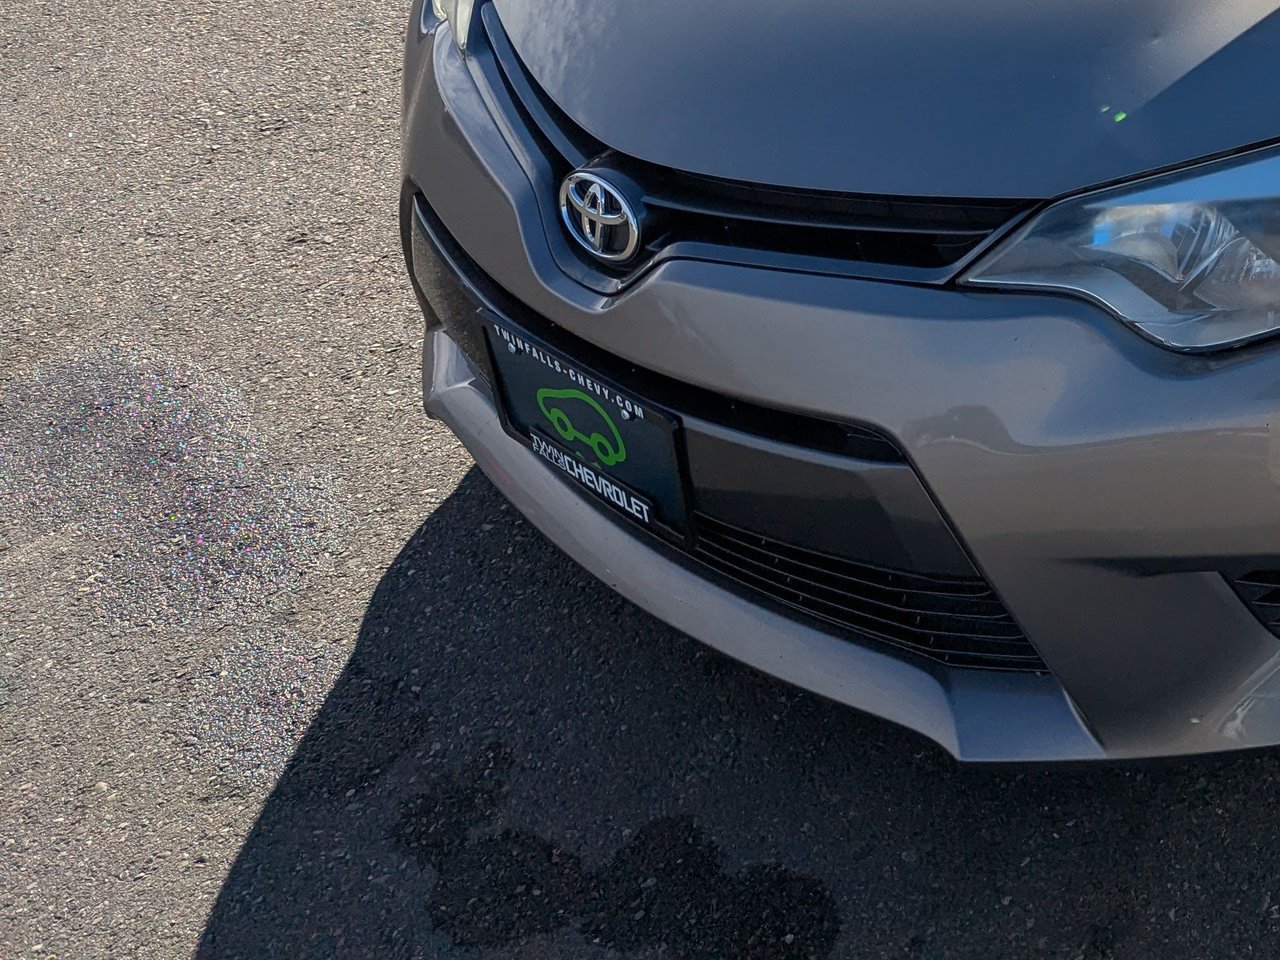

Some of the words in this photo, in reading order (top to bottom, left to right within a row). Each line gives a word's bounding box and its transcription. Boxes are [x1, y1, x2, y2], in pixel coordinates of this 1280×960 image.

[494, 324, 644, 419] TWINFALLS-CHEVY.COM
[530, 433, 564, 462] TWIN
[533, 442, 566, 470] FALLS
[564, 455, 649, 523] CHEVROLET
